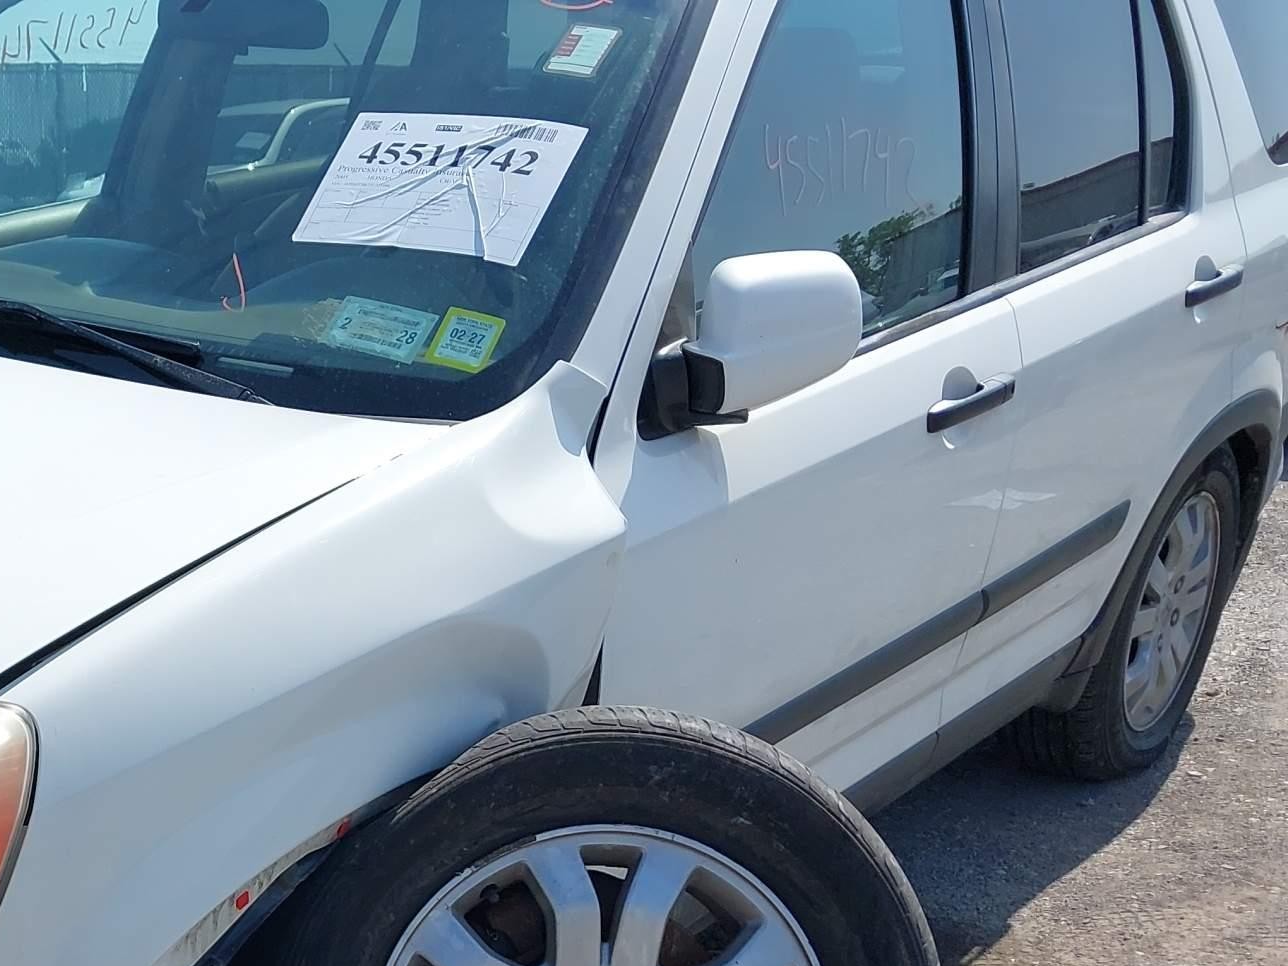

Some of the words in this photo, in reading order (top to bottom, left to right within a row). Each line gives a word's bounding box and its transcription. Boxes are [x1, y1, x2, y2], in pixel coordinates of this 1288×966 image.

[358, 141, 540, 176] 45511742
[337, 165, 390, 174] Progressive
[339, 317, 352, 330] 2
[396, 330, 418, 344] 28
